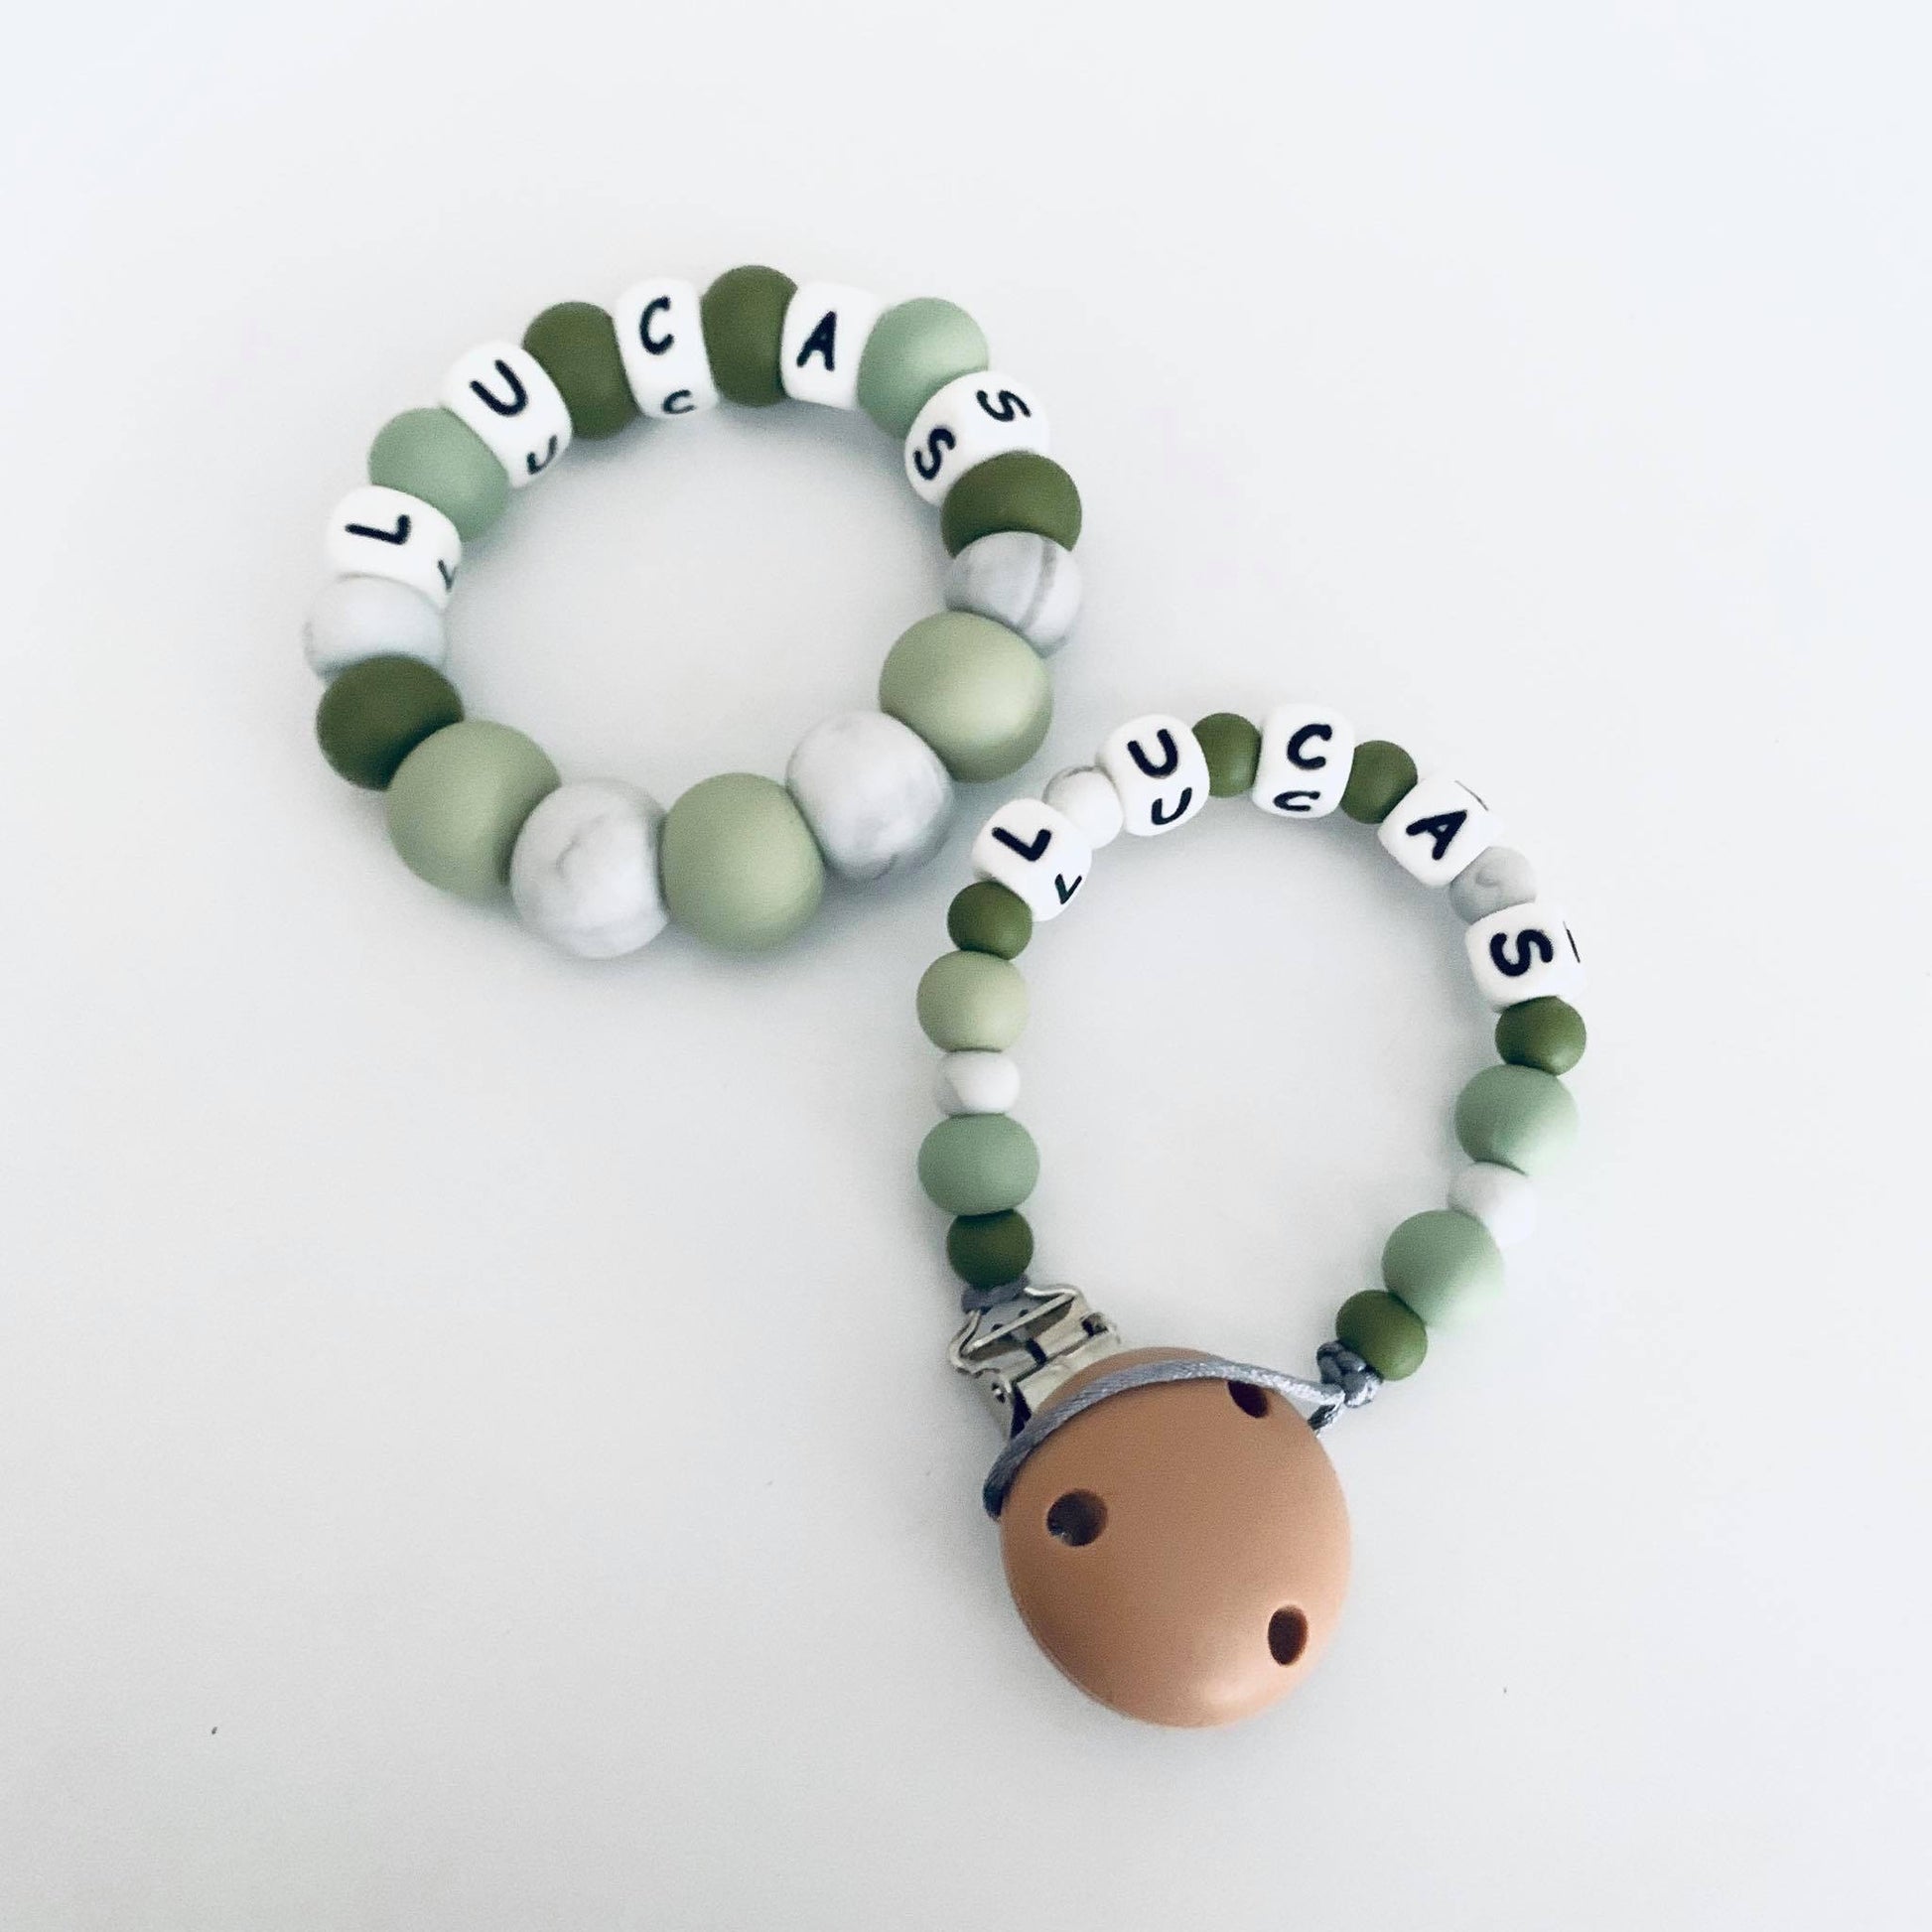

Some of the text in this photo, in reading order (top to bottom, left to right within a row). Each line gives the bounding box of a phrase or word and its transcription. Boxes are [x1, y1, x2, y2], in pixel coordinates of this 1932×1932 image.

[345, 296, 1032, 545] L U C A S
[912, 425, 956, 481] S
[992, 827, 1052, 862] L
[1127, 729, 1178, 779] U
[1287, 724, 1332, 770] C
[1406, 809, 1467, 861] A
[1489, 929, 1554, 978] S
